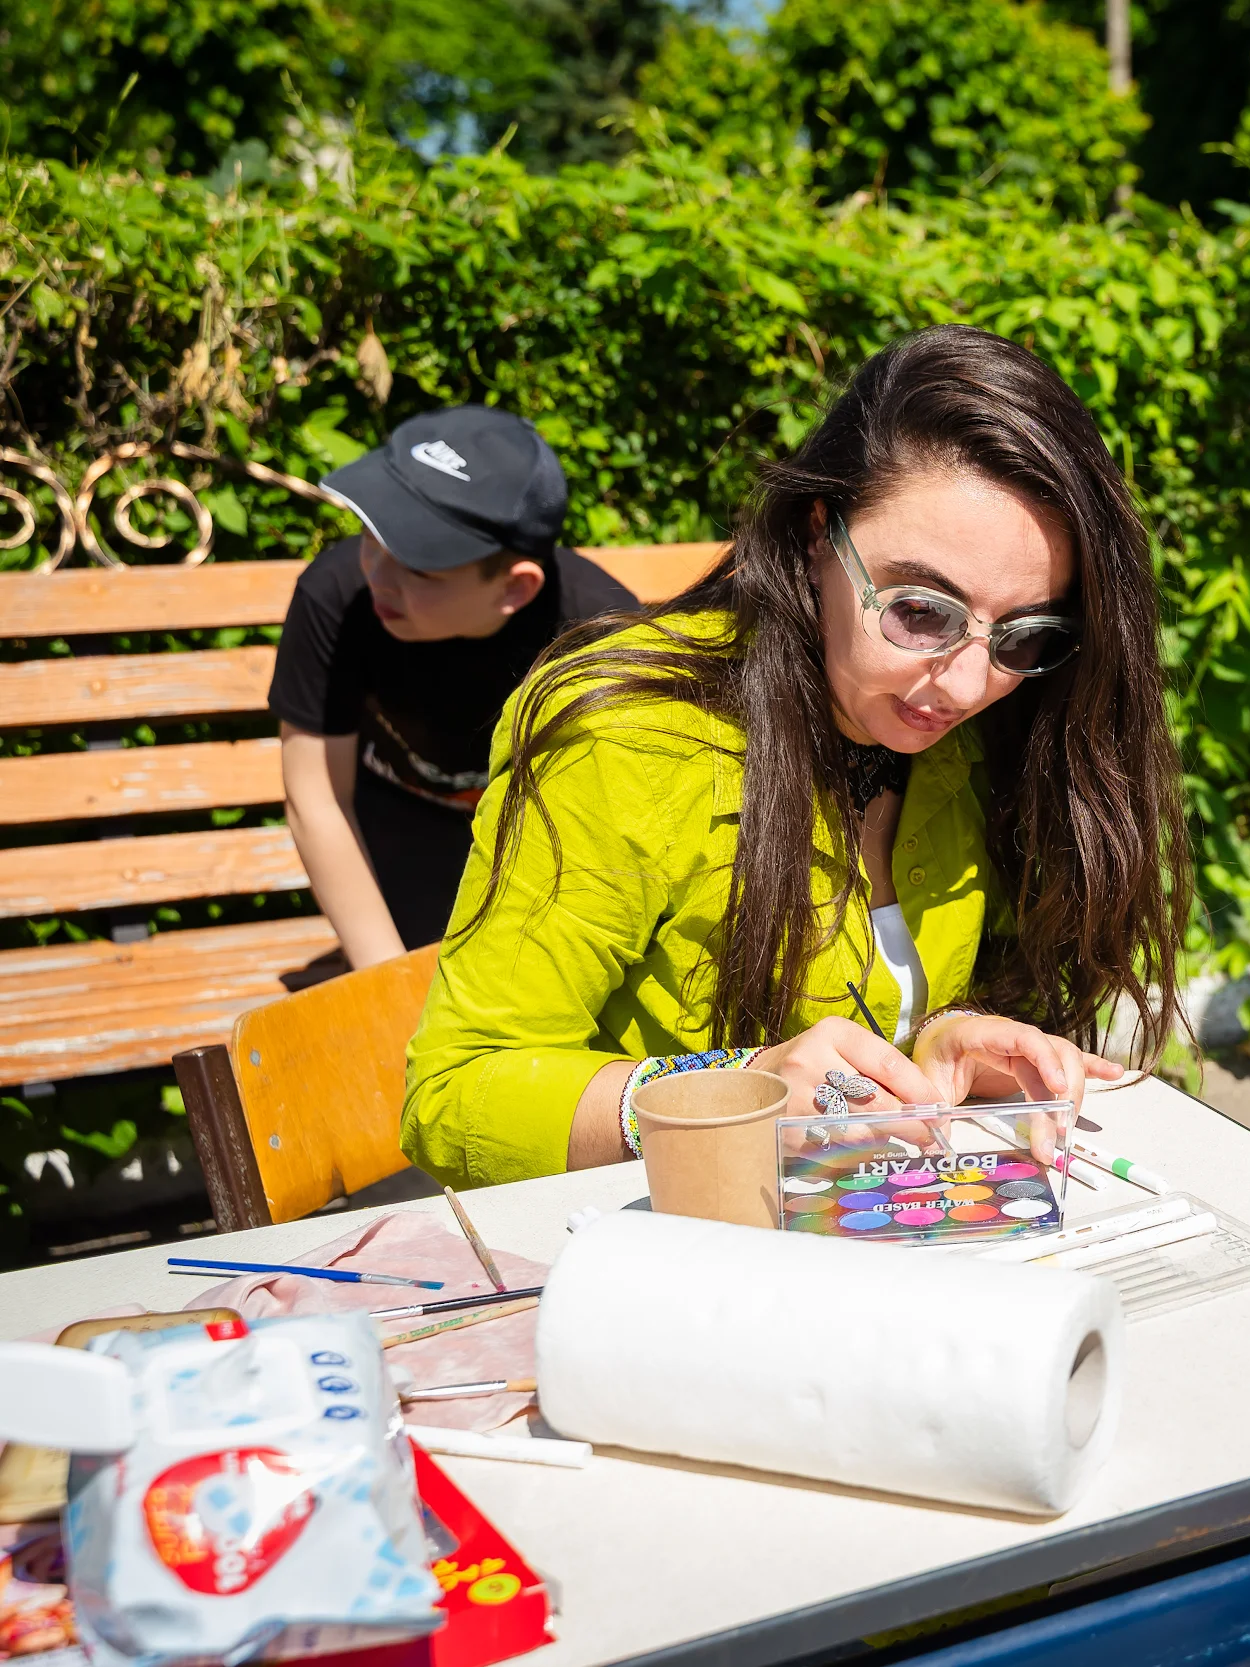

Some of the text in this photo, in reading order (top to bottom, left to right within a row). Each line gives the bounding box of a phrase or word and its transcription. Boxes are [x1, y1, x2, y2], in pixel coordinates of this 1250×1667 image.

[853, 1154, 998, 1178] BODY ART
[872, 1199, 975, 1212] WATER BASED
